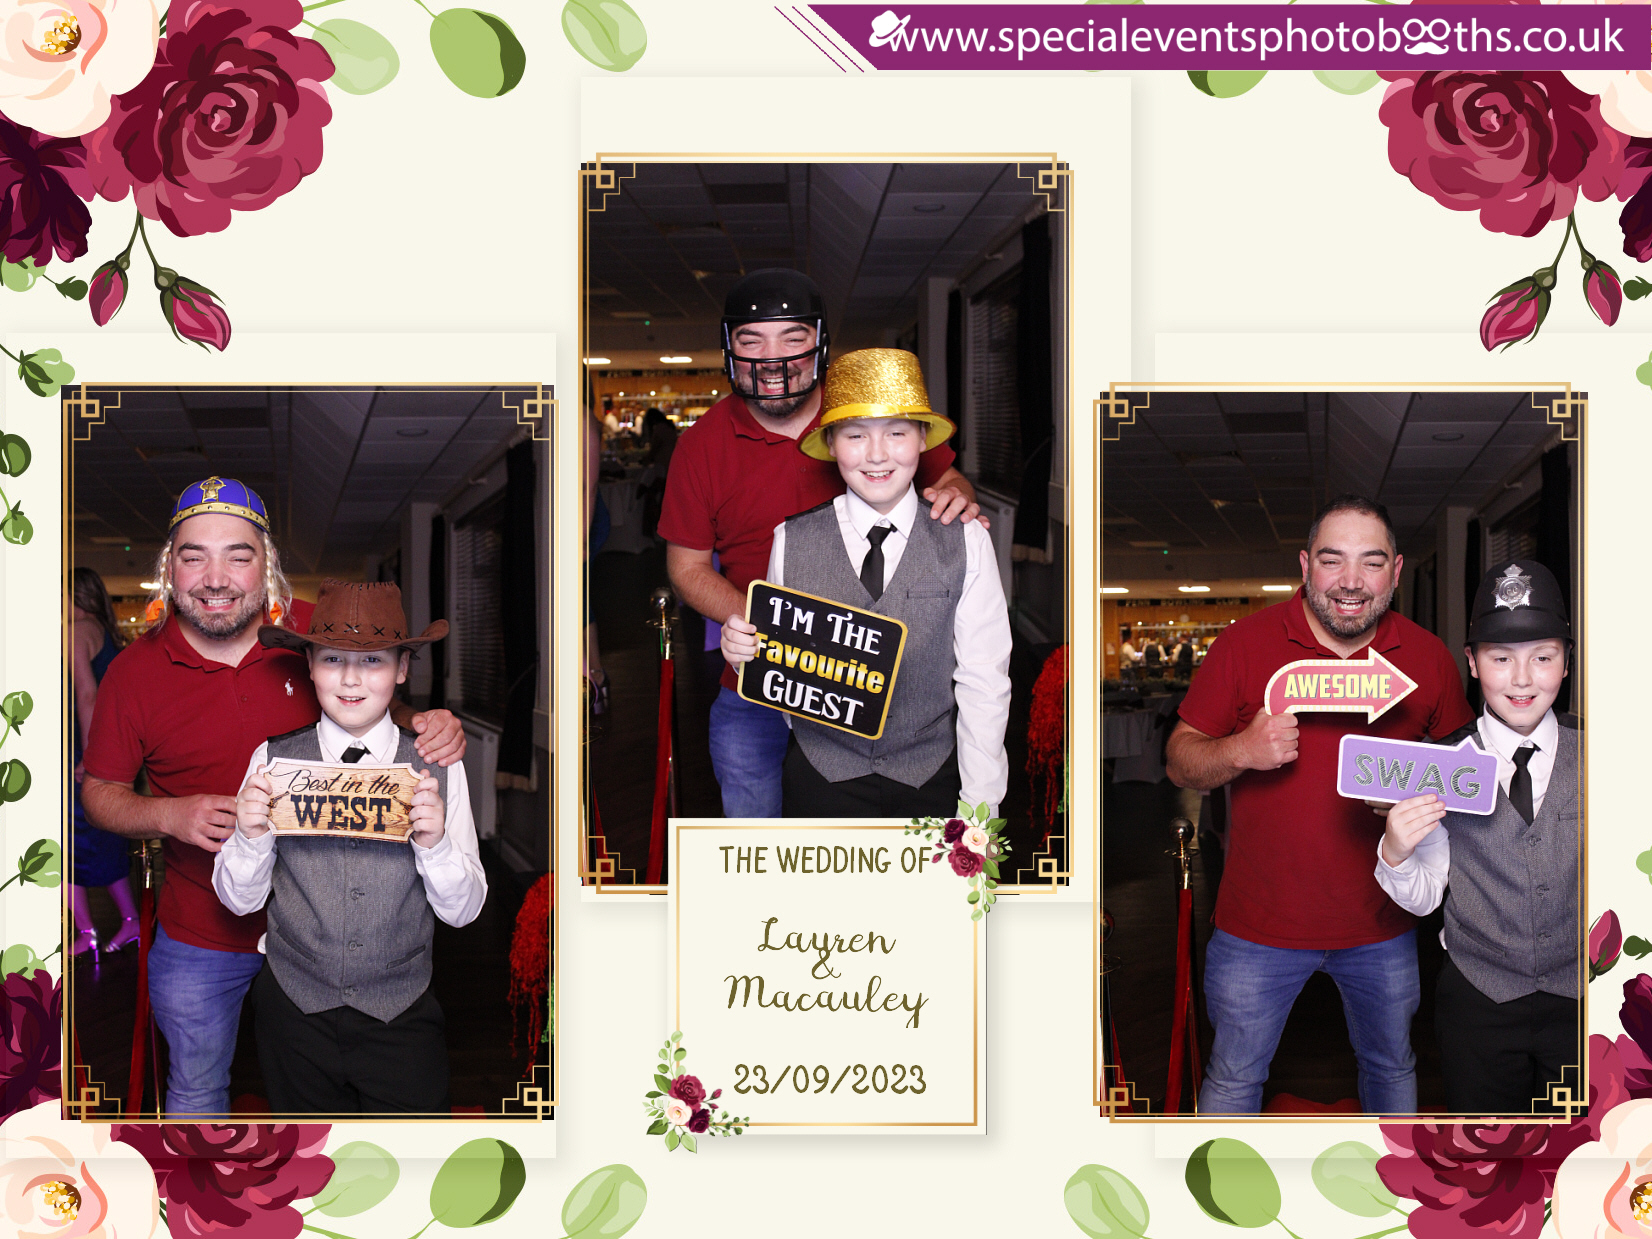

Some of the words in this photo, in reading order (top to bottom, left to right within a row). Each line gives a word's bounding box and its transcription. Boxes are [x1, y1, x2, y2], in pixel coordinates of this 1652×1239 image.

[769, 596, 815, 636] I'M
[827, 612, 882, 655] THE
[754, 631, 886, 694] Favourite
[762, 669, 864, 726] GUEST
[1284, 673, 1392, 699] AWESOME
[269, 769, 343, 793] Best
[341, 776, 363, 794] in
[368, 774, 400, 796] the
[1353, 753, 1481, 799] SWAG
[290, 794, 392, 832] WEST
